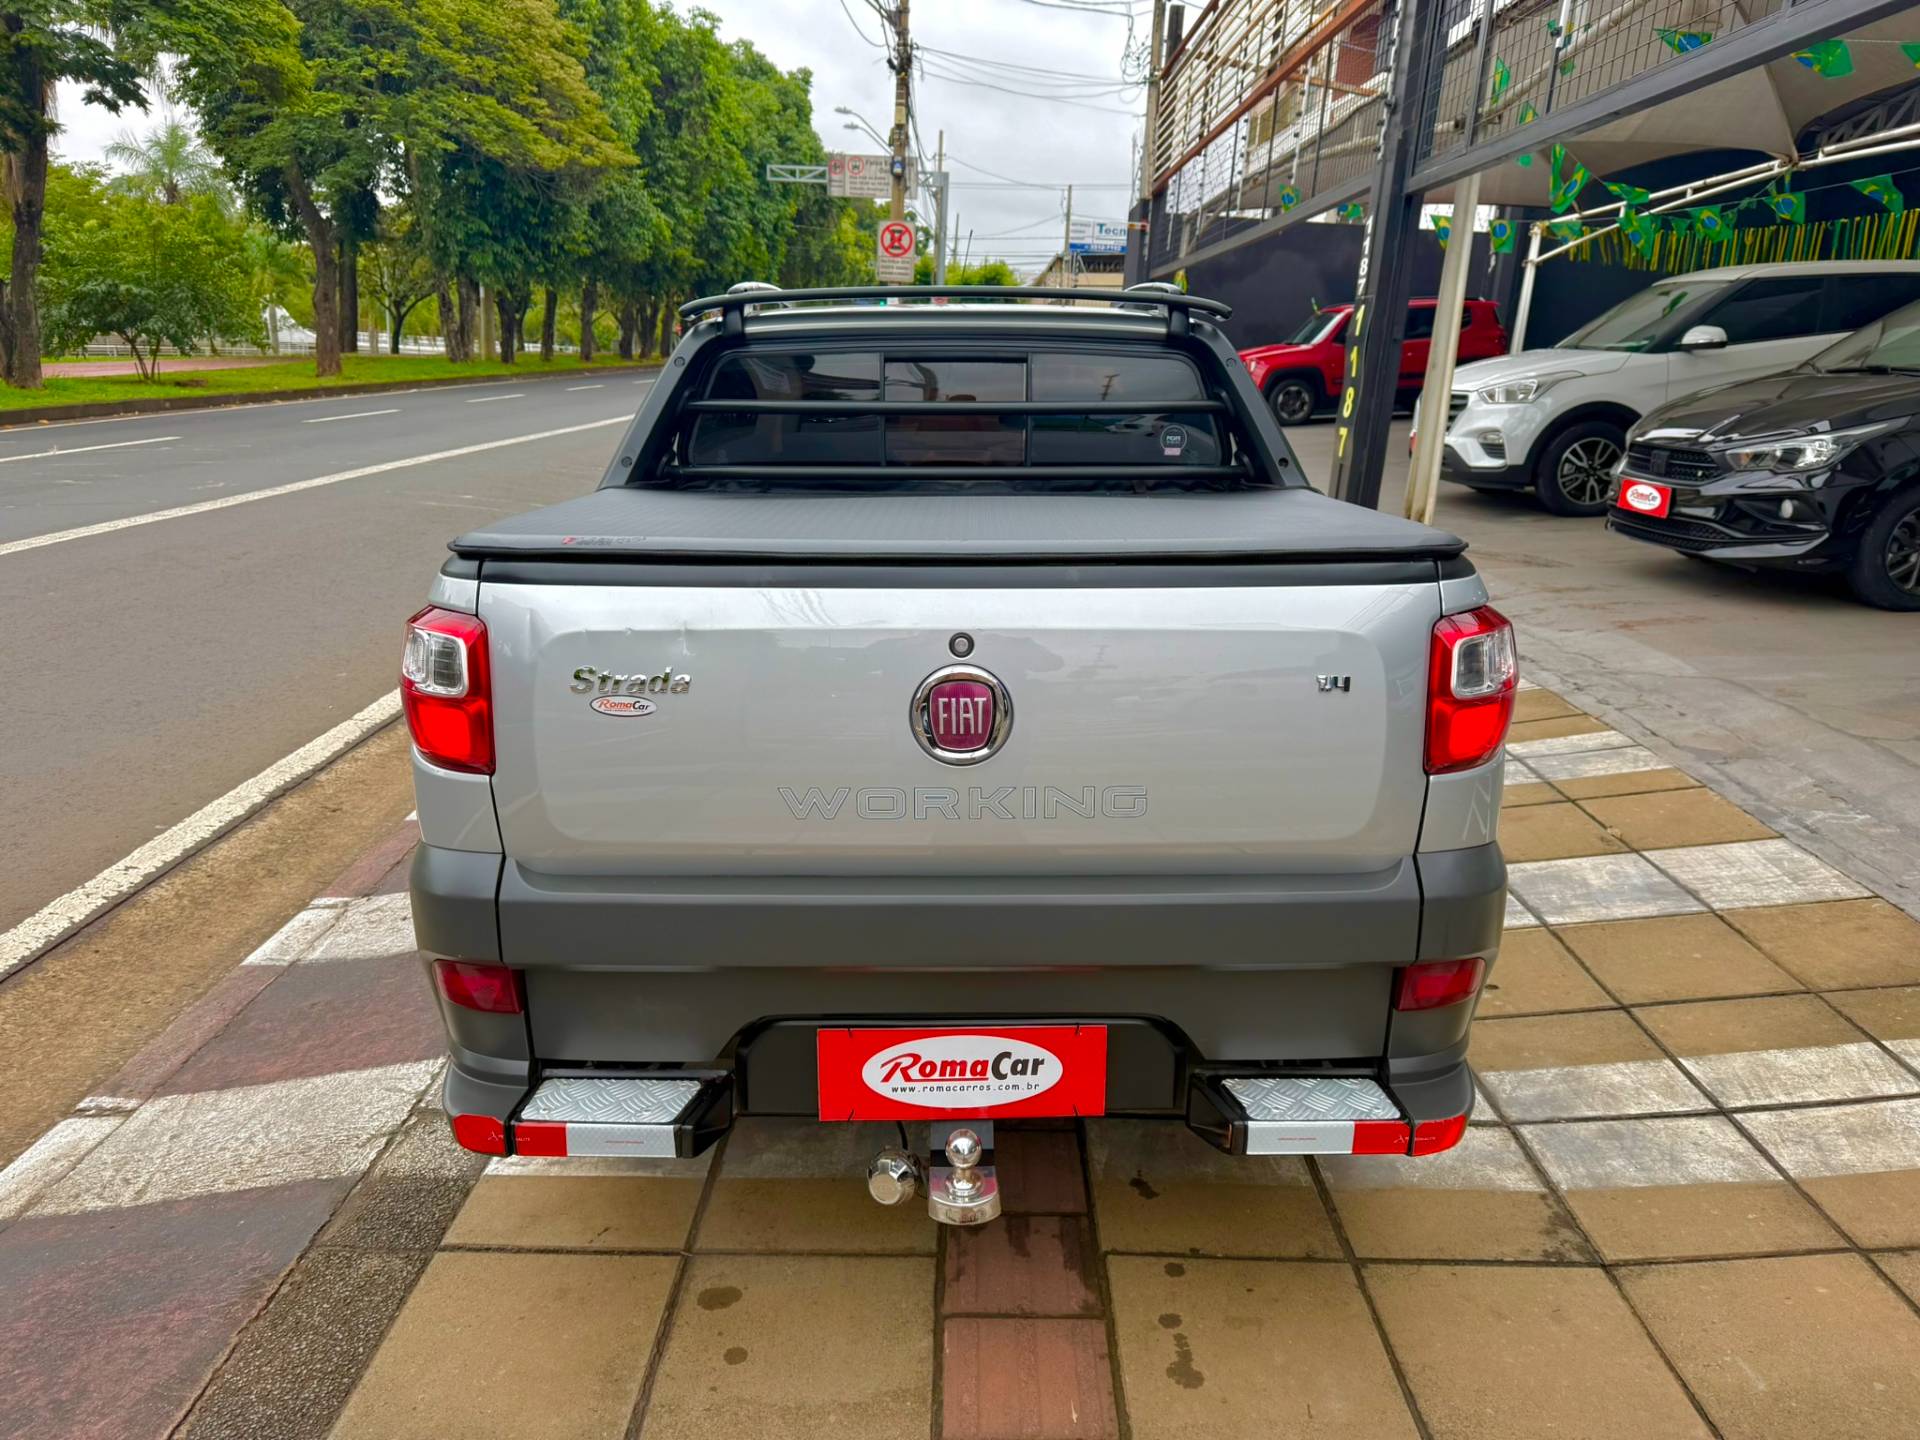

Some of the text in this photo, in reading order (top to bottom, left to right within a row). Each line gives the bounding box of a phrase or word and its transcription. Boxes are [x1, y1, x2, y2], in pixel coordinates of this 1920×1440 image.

[568, 665, 691, 694] Strada
[596, 699, 651, 711] RomaCar
[938, 697, 987, 735] FIAT
[777, 785, 1148, 820] WORKING
[880, 1051, 1045, 1083] RomaCar
[891, 1083, 1040, 1093] www.romacarros.com.br
